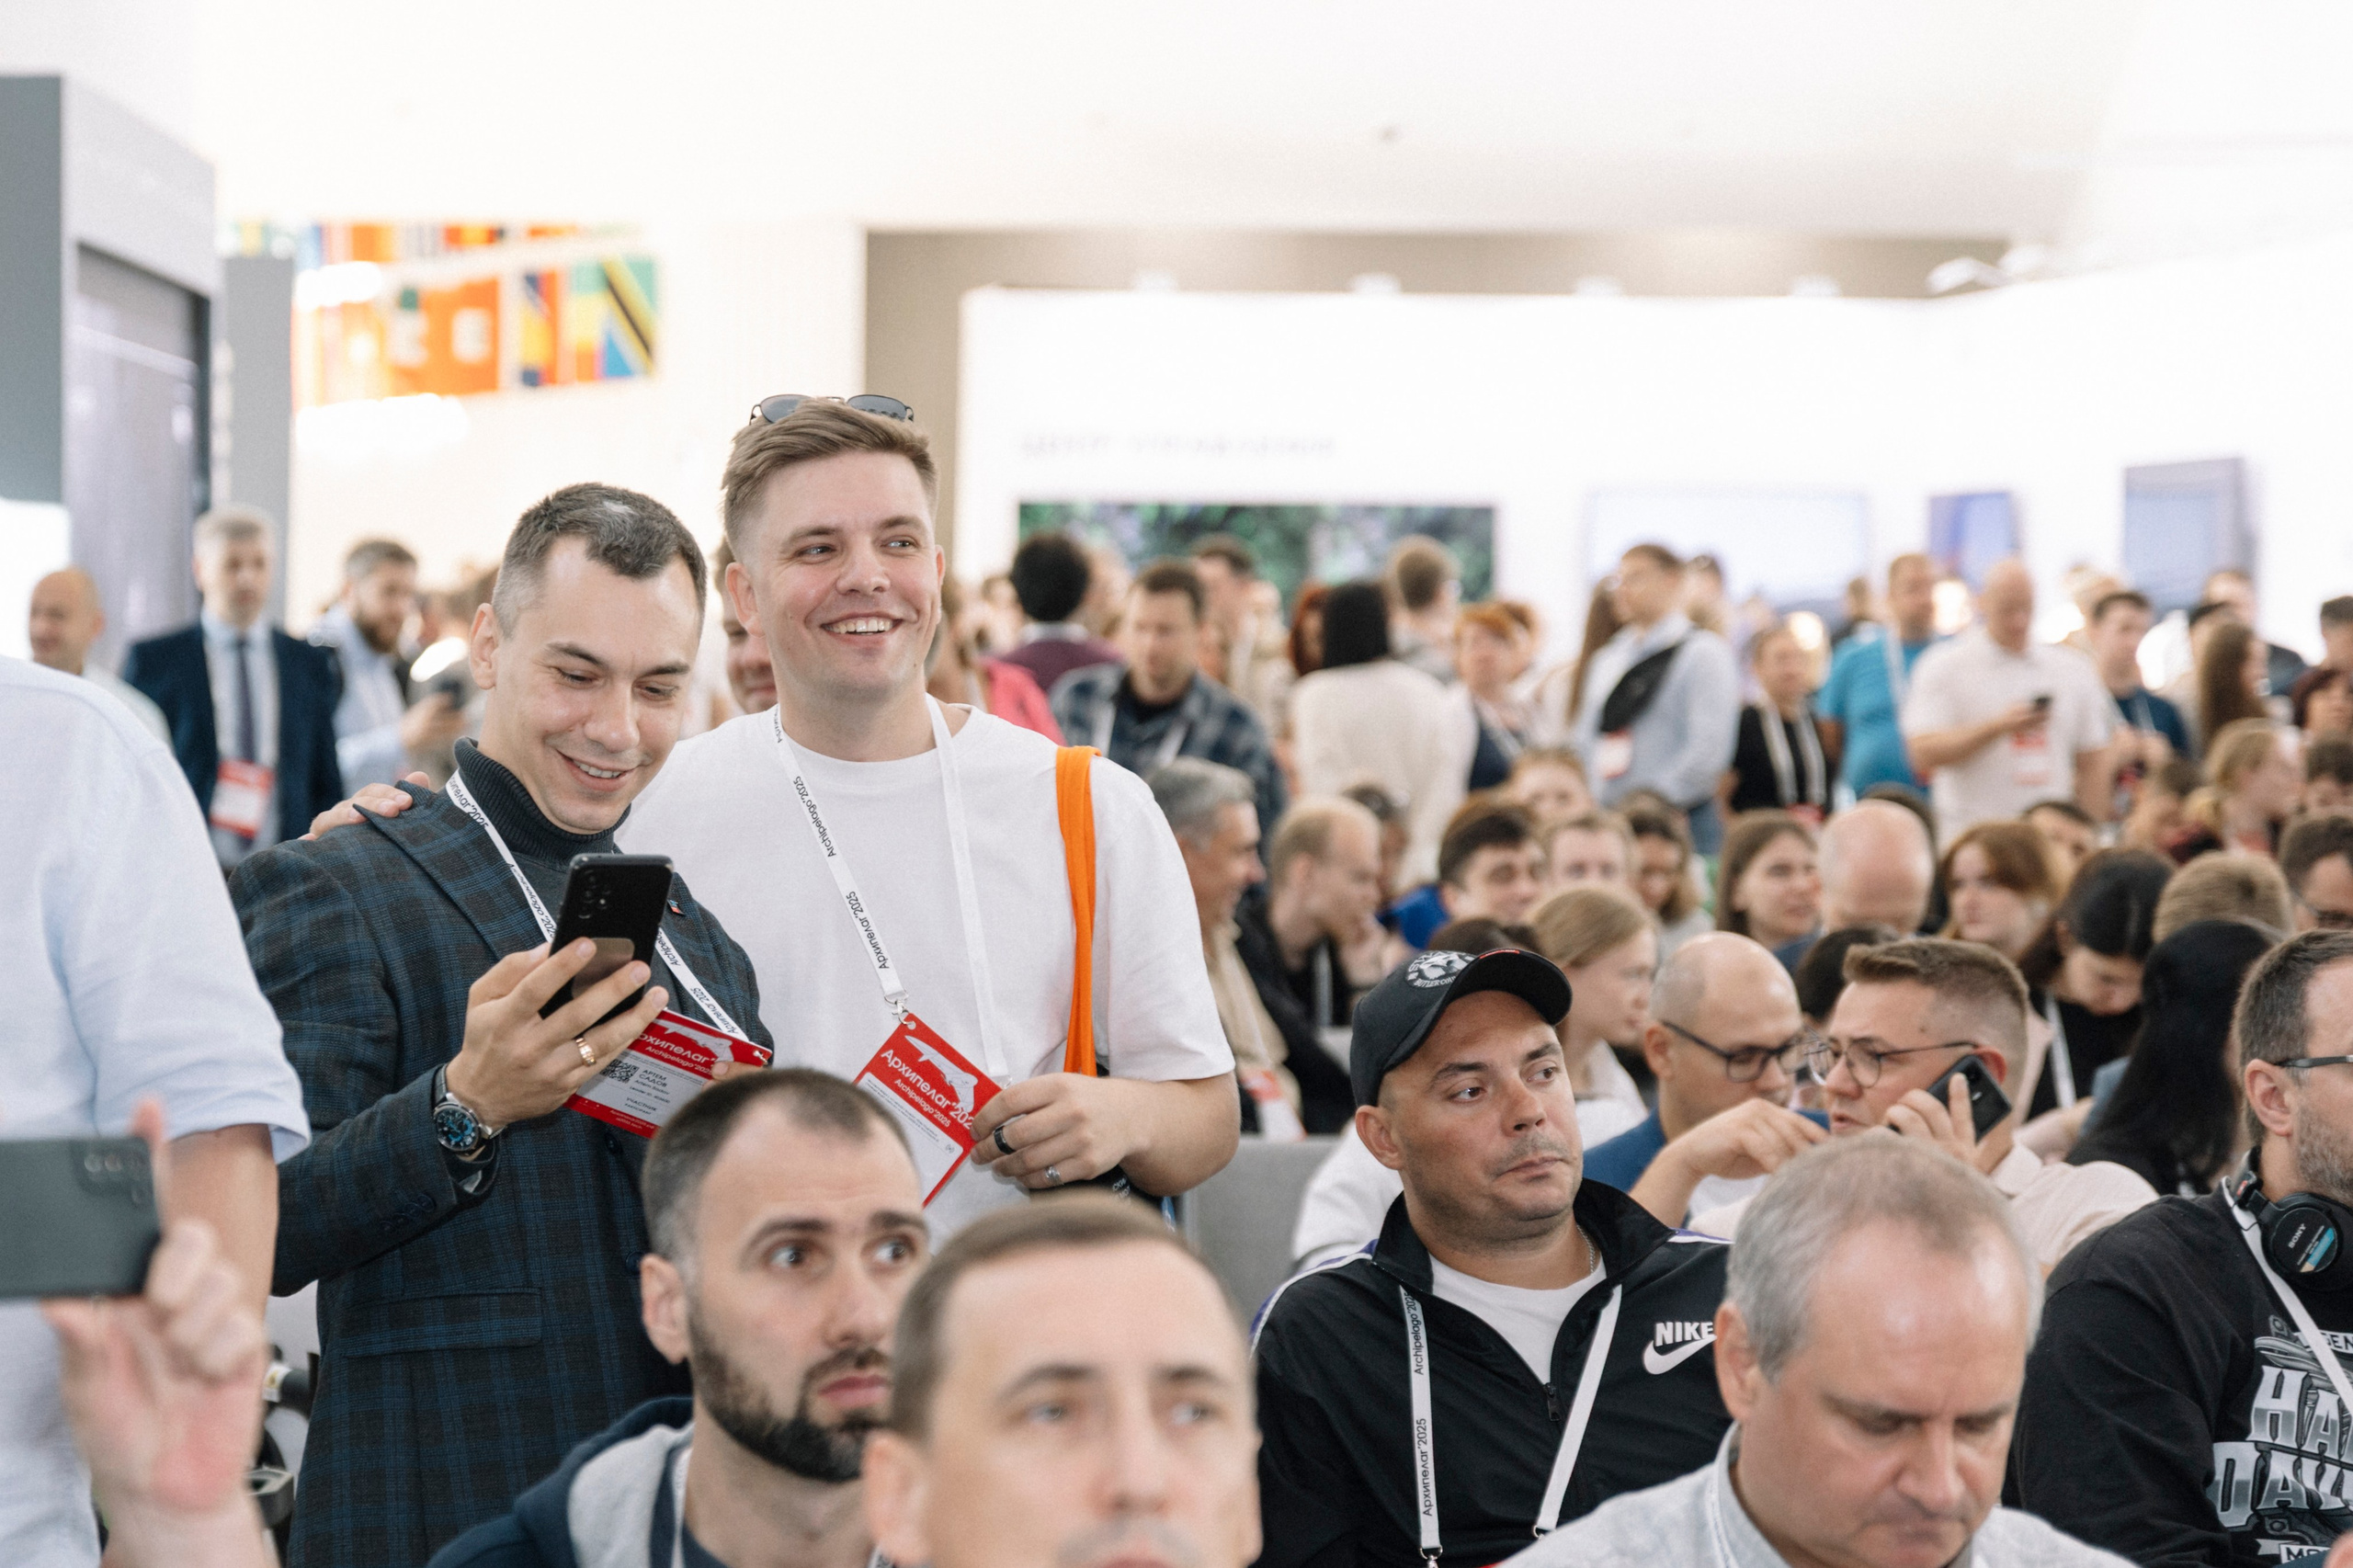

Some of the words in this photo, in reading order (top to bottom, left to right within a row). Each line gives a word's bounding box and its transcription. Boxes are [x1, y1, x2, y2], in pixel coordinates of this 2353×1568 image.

[792, 775, 837, 858] Archipelago'2025
[846, 891, 891, 970] Архипелаг'2025
[1414, 978, 1441, 988] BUTLER
[639, 1074, 668, 1088] САДОВ
[642, 1069, 667, 1082] АРТЕМ
[881, 1049, 975, 1131] Архипелаг'202
[893, 1078, 951, 1129] Archipelago'2025
[2288, 1222, 2307, 1249] SONY
[1655, 1321, 1714, 1347] NIKE
[2245, 1364, 2353, 1463] HA
[1415, 1417, 1434, 1517] Архипелаг'2025
